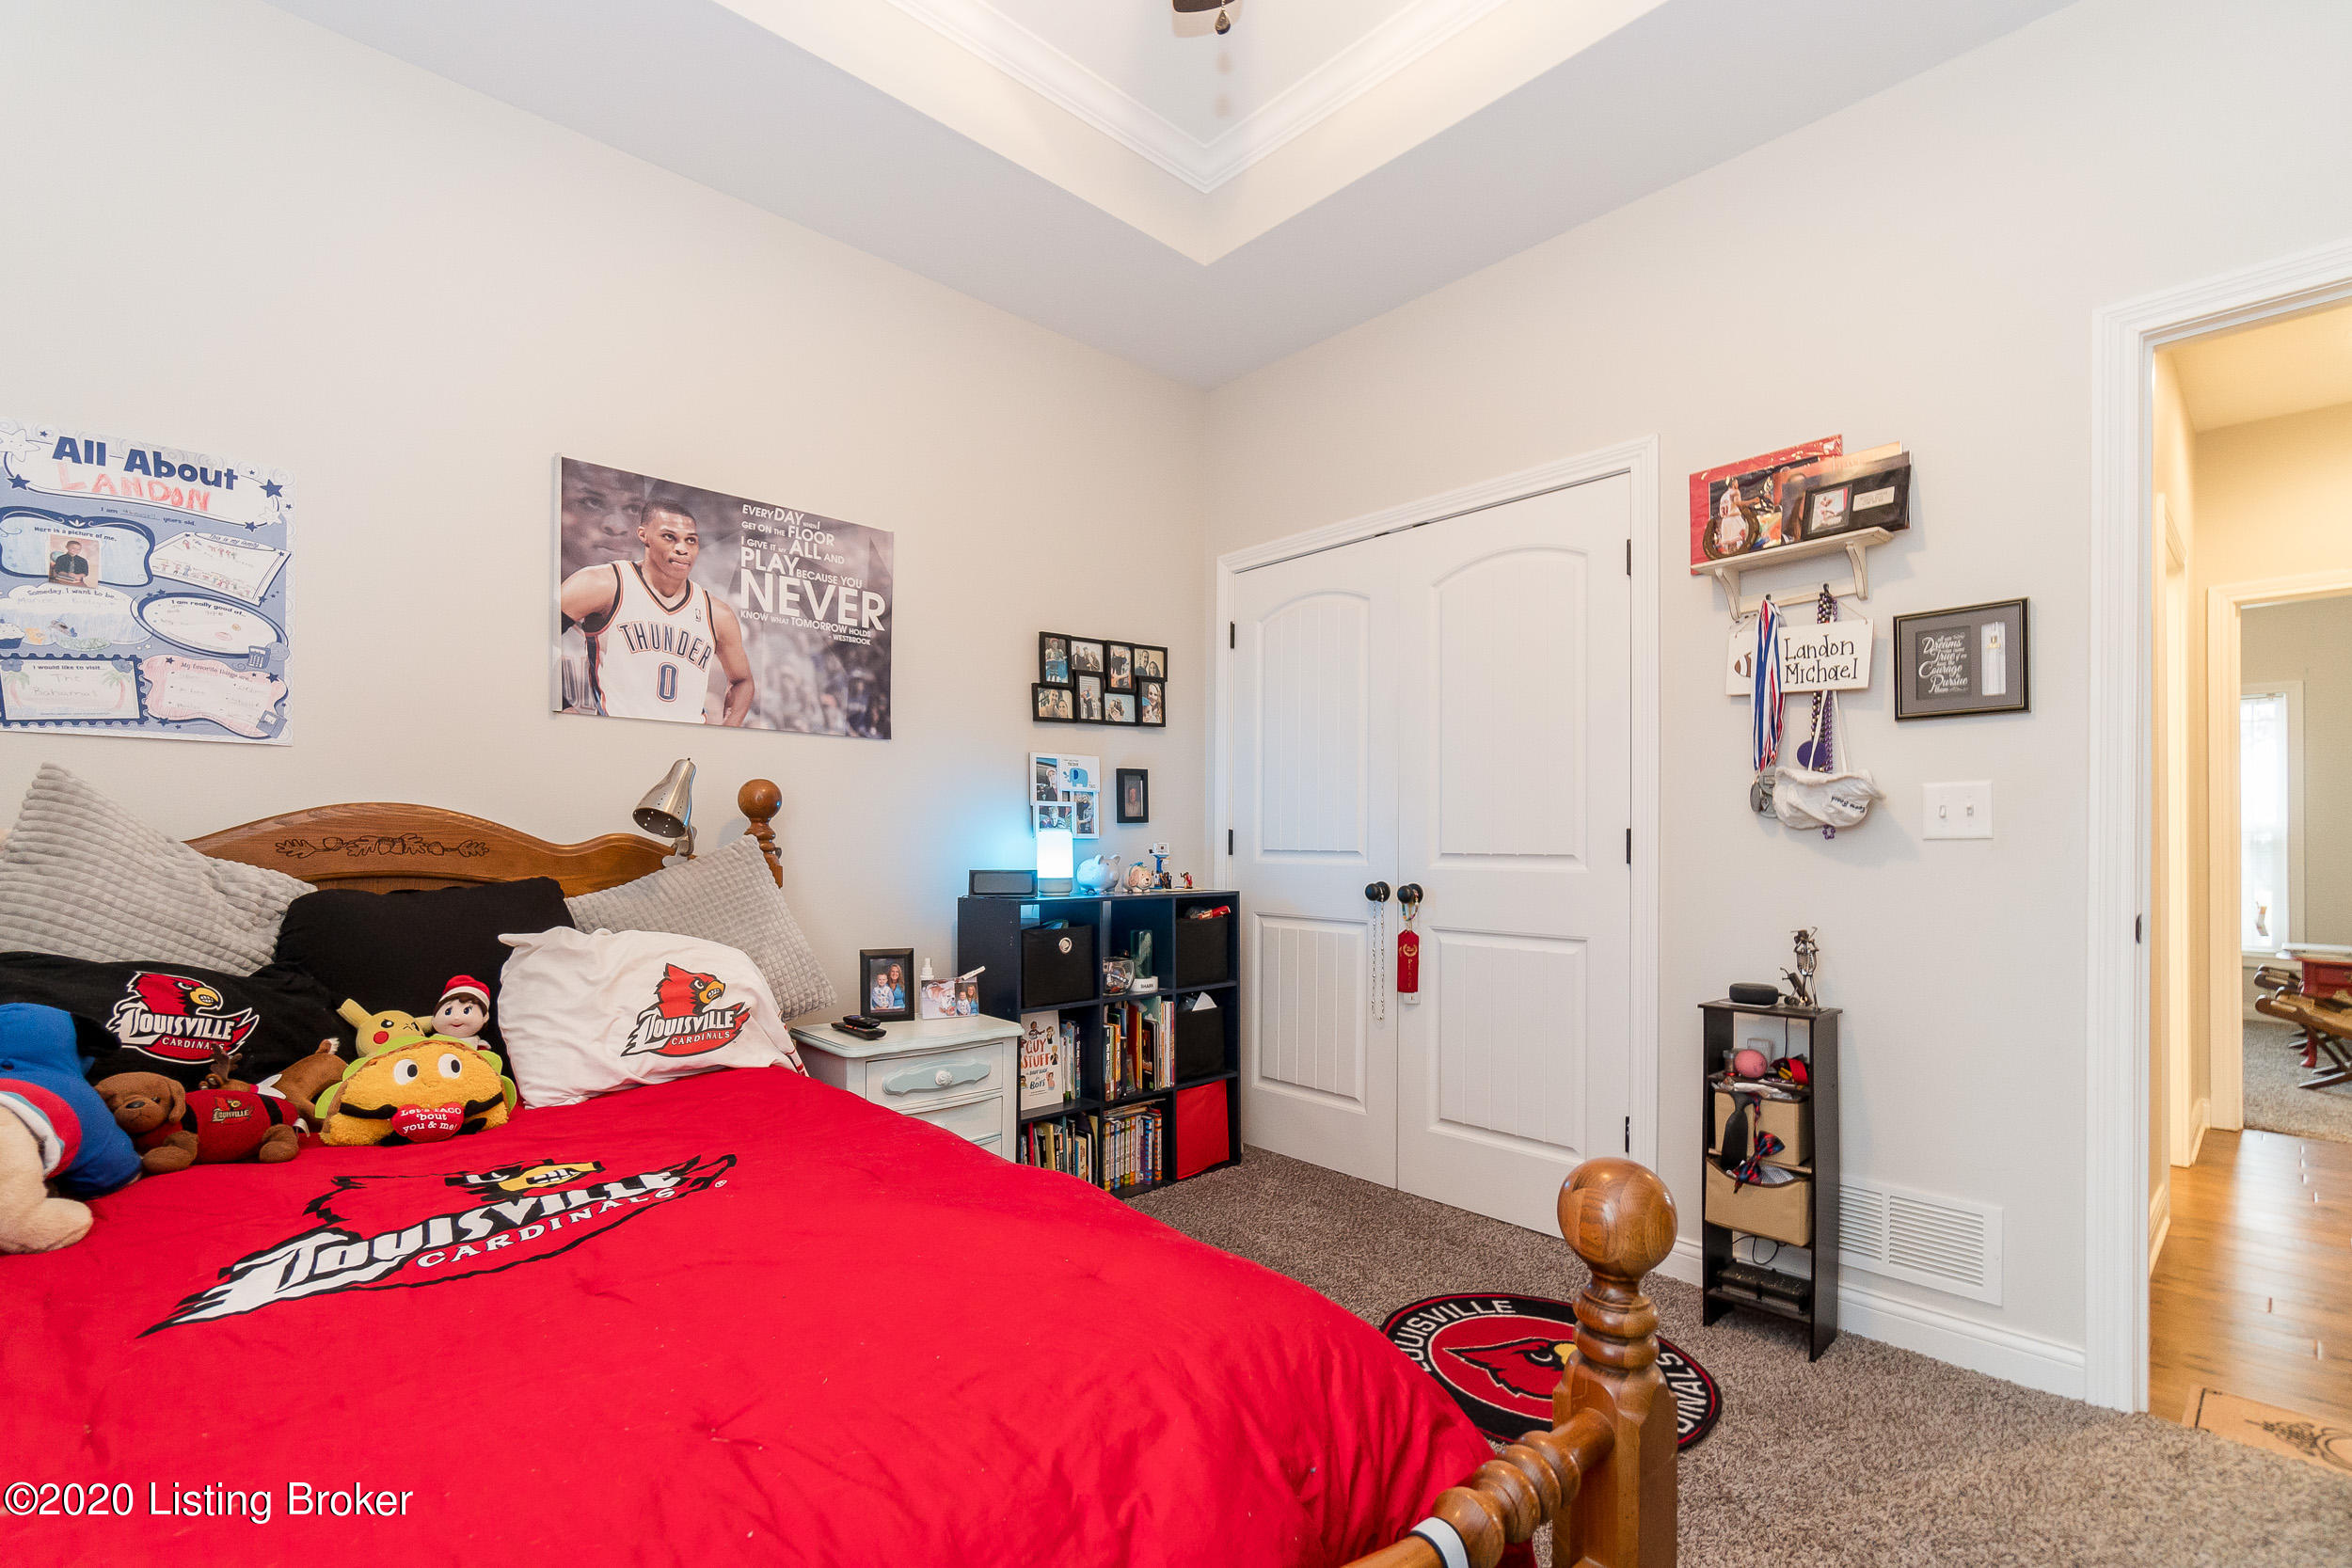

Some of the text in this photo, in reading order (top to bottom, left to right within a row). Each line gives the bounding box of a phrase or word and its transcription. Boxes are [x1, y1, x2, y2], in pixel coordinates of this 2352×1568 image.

[52, 436, 238, 490] All About
[57, 462, 210, 512] LANDON
[68, 530, 94, 538] picture
[741, 521, 835, 546] GET ON THE FLOOR
[746, 539, 768, 550] GIVE
[788, 540, 821, 560] ALL
[823, 553, 845, 564] AND
[740, 546, 863, 589] PLAY BECAUSE YOU
[214, 604, 232, 612] good
[740, 568, 886, 631] NEVER
[740, 610, 871, 638] KNOW WHAT TOMORROW HOLDS
[617, 621, 712, 672] THUNDER
[1784, 634, 1854, 661] Landon
[1922, 636, 1963, 656] Dreams
[657, 661, 679, 703] 0
[1785, 657, 1858, 685] Michael
[1918, 660, 1963, 678] Courage
[1929, 673, 1968, 693] Pursue
[113, 1001, 235, 1045] LOUISVILLE
[627, 1007, 735, 1053] LOUISVILLE
[162, 1037, 224, 1051] CARDINAS
[671, 1031, 730, 1046] CARDINALS
[1025, 1037, 1046, 1053] GUY
[1023, 1053, 1051, 1069] STUFF
[212, 1108, 250, 1123] LOUISVILLE
[403, 1122, 425, 1133] you
[439, 1122, 457, 1131] me!
[417, 1186, 676, 1269] CARDINALS
[170, 1171, 685, 1323] LOUISVILLE
